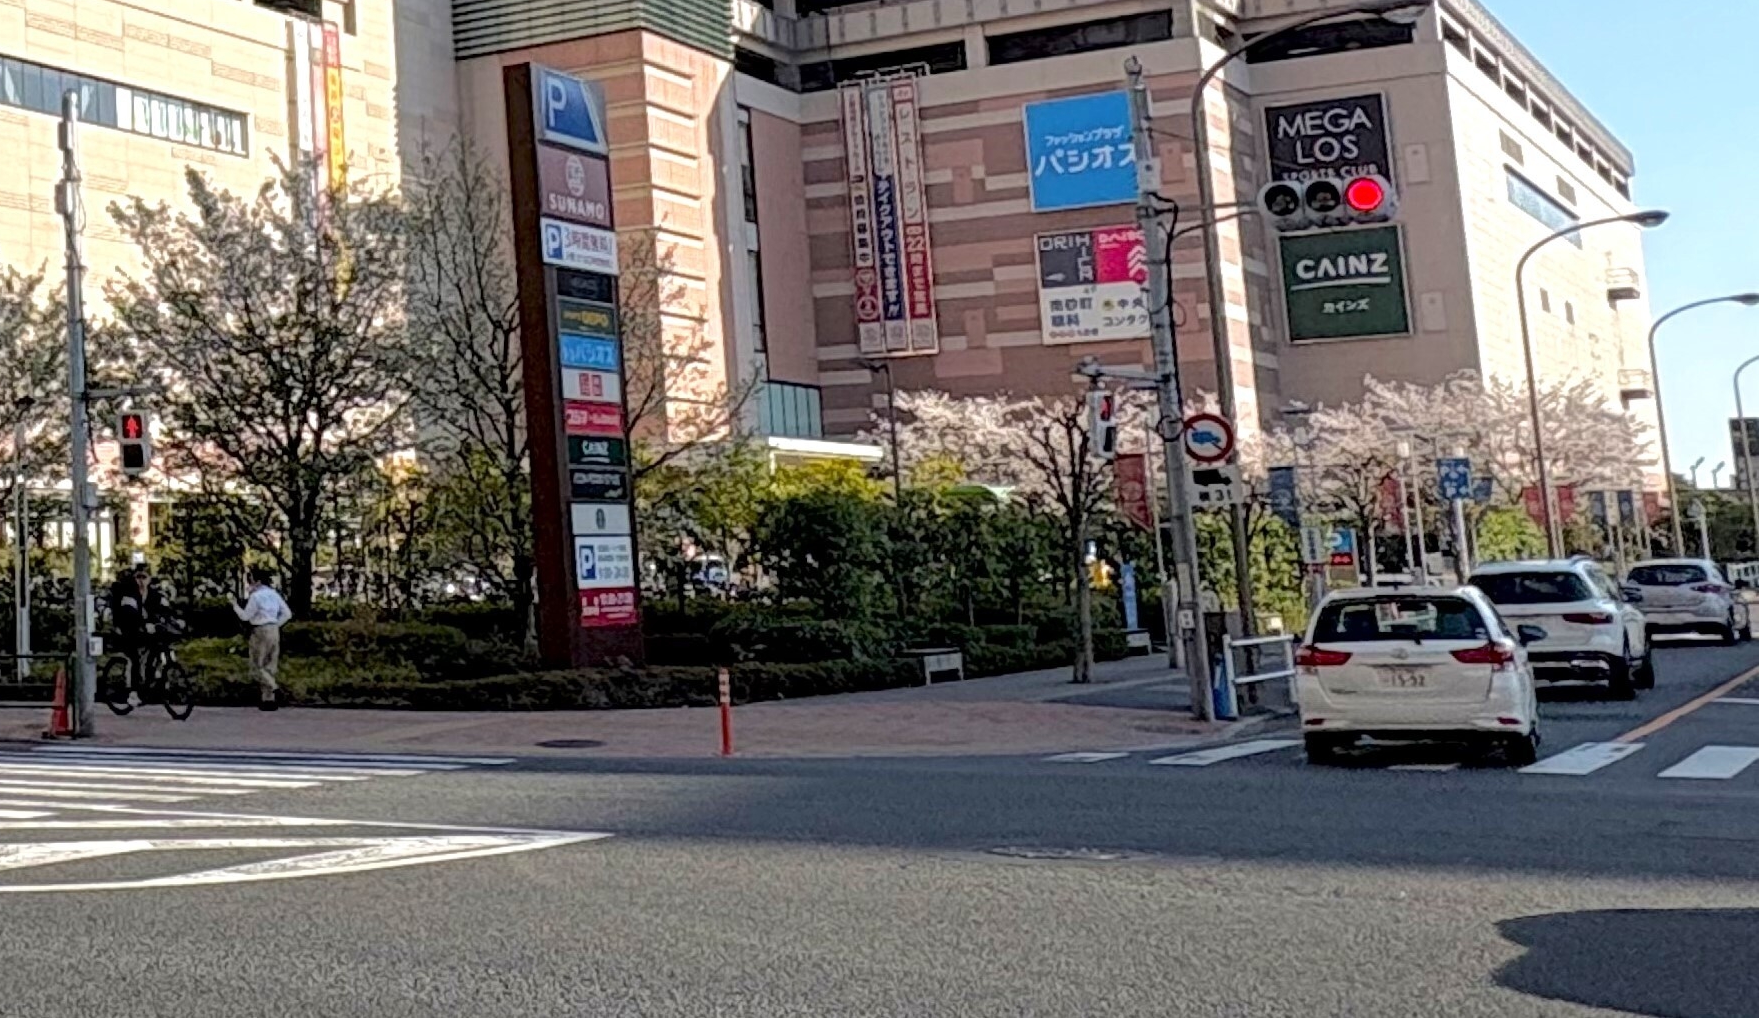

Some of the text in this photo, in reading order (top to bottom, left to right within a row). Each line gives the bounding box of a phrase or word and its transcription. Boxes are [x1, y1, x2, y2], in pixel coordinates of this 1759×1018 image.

[545, 76, 567, 127] P
[1277, 107, 1373, 139] MEGA
[1035, 142, 1137, 177] パシオス
[1295, 135, 1360, 164] LOS
[549, 192, 606, 220] SUNAMO
[1296, 253, 1389, 280] CAINZ
[1322, 298, 1370, 314] カインズ
[1102, 314, 1149, 328] コンタク
